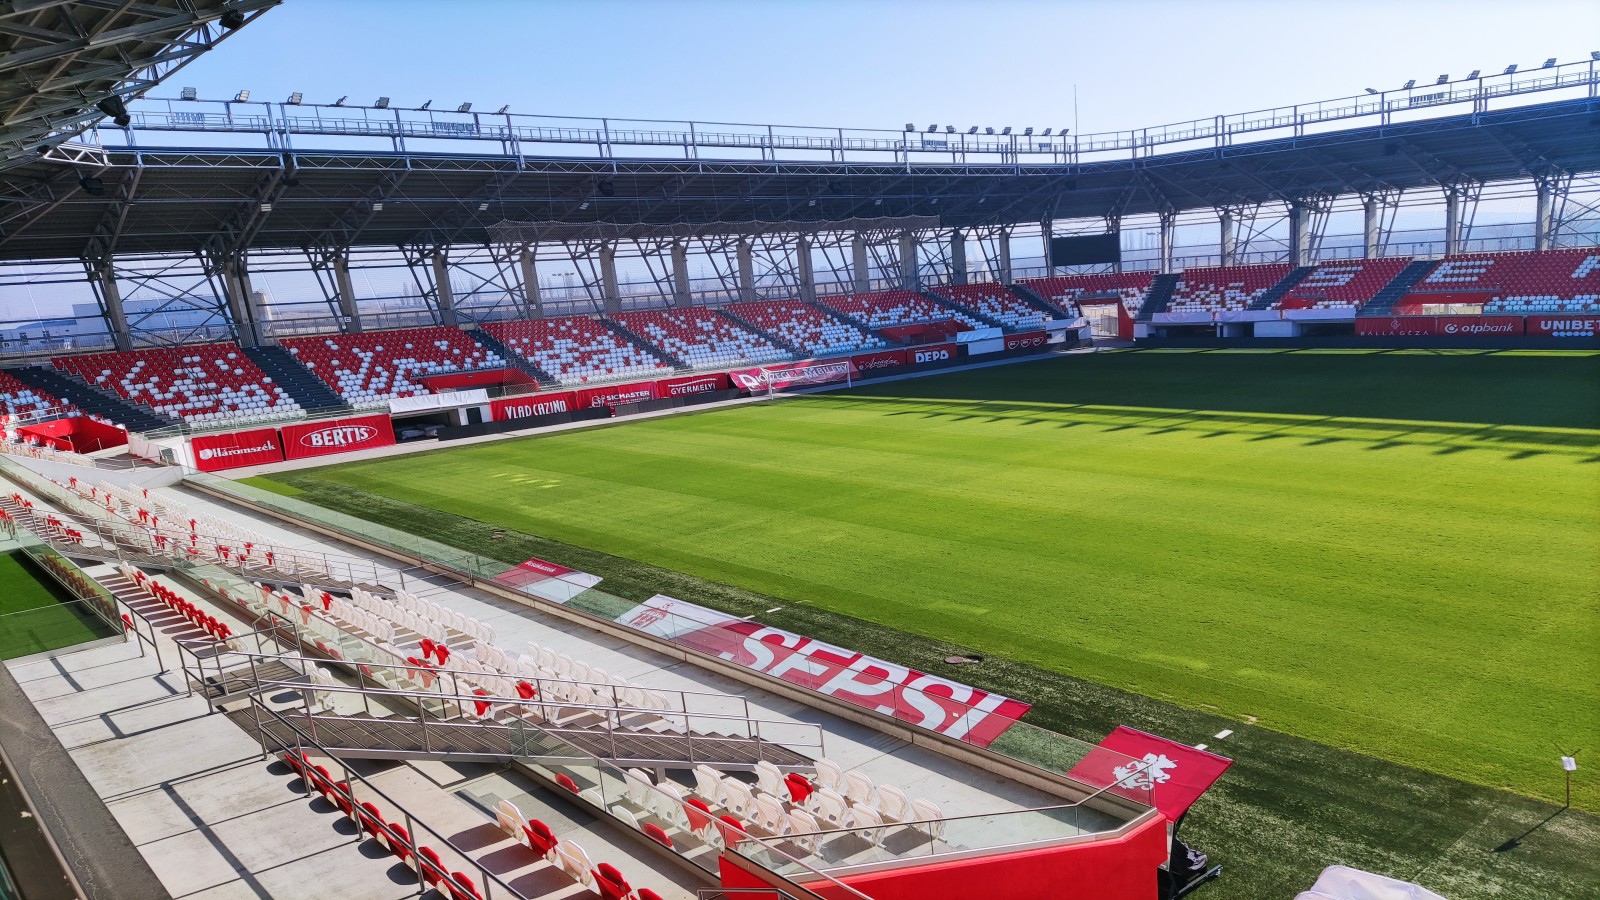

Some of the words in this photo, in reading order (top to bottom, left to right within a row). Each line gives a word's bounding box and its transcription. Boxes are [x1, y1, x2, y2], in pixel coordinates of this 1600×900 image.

[1461, 322, 1514, 334] otpbank
[606, 390, 650, 401] SICMASTER
[670, 382, 716, 395] GYERMELYI
[504, 405, 532, 420] VLAD
[533, 399, 567, 416] CAZINO
[310, 426, 369, 446] BERTIS
[212, 440, 276, 458] Háromszék
[718, 626, 1010, 741] SEPSI
